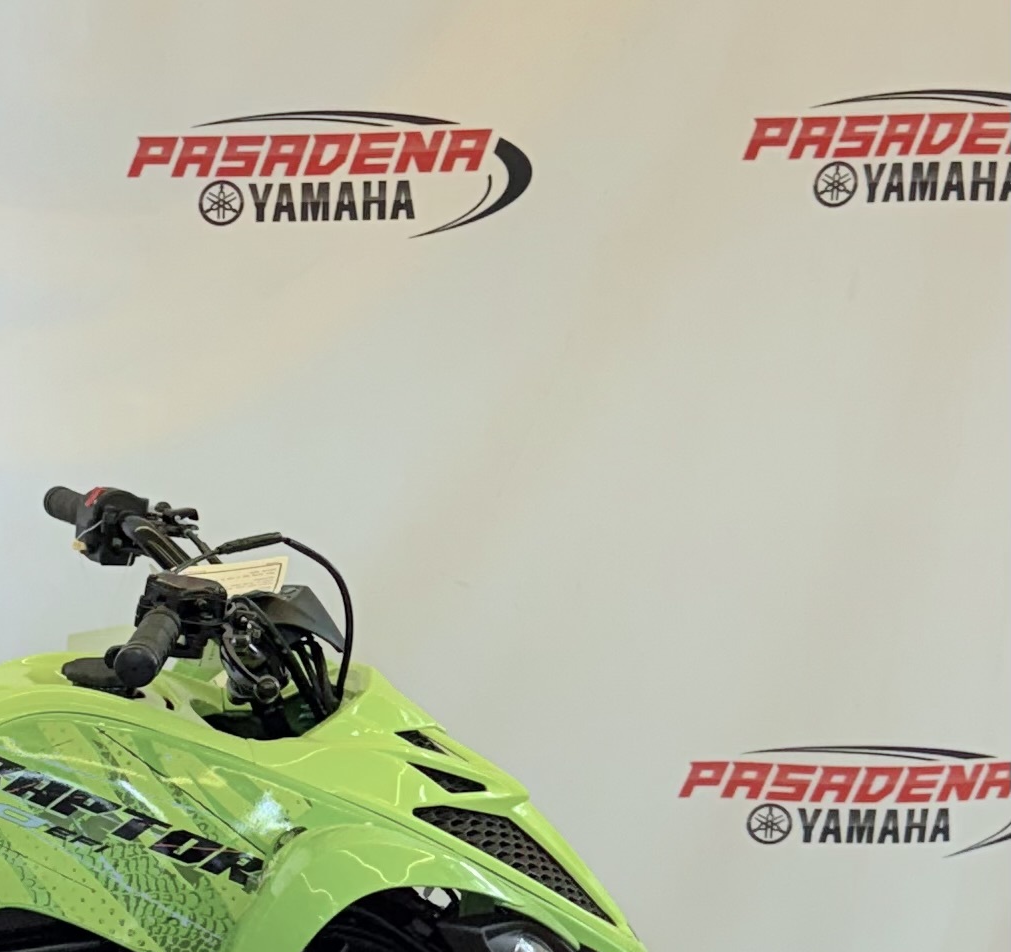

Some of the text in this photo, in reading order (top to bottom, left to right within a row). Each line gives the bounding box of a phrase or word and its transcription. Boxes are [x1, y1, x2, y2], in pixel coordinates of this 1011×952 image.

[127, 129, 492, 178] PASADENA
[742, 112, 1011, 160] PASADE
[248, 180, 415, 222] YAMAHA
[678, 761, 1011, 803] PASADENA
[797, 807, 950, 844] YAMAHA
